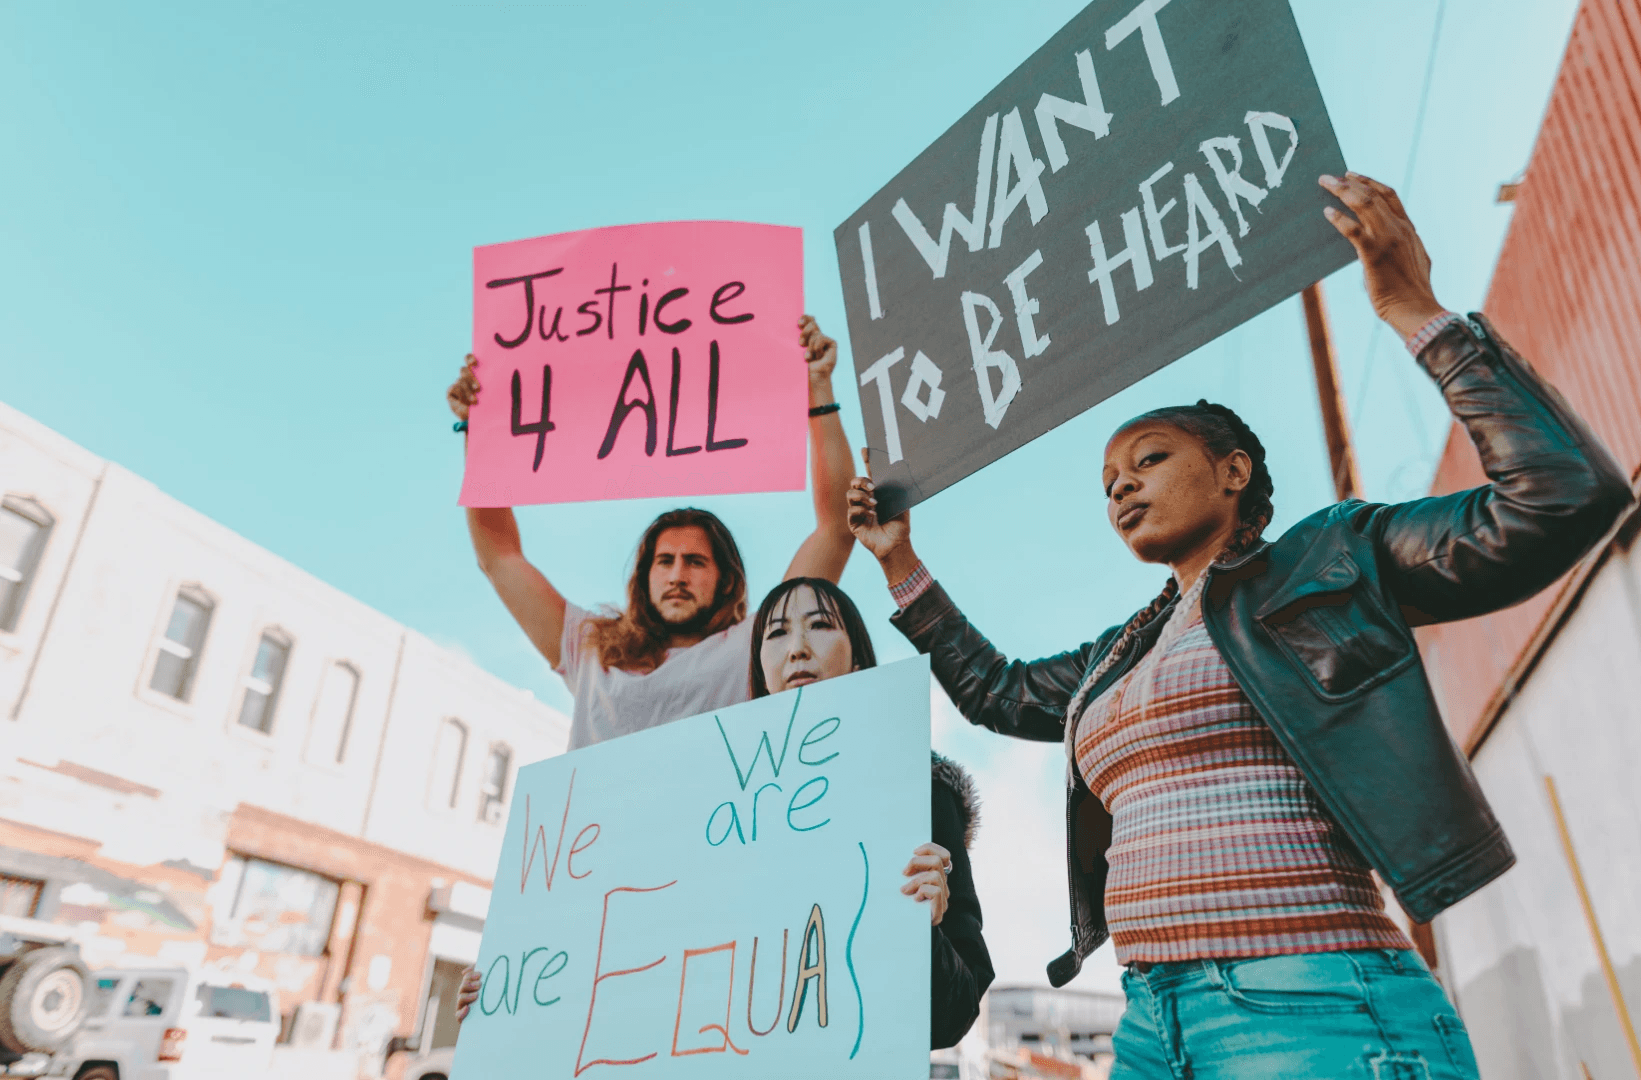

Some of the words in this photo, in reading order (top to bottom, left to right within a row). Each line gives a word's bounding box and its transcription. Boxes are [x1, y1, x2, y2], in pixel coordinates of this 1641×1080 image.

[859, 221, 888, 321] I
[892, 0, 1181, 280] WANT
[486, 262, 754, 349] Justice
[960, 250, 1052, 430] BE
[1085, 110, 1299, 326] HEARD
[511, 364, 556, 472] 4
[597, 339, 748, 460] ALL
[715, 685, 841, 791] We
[521, 768, 601, 894] We
[706, 776, 831, 846] are
[480, 947, 569, 1016] are
